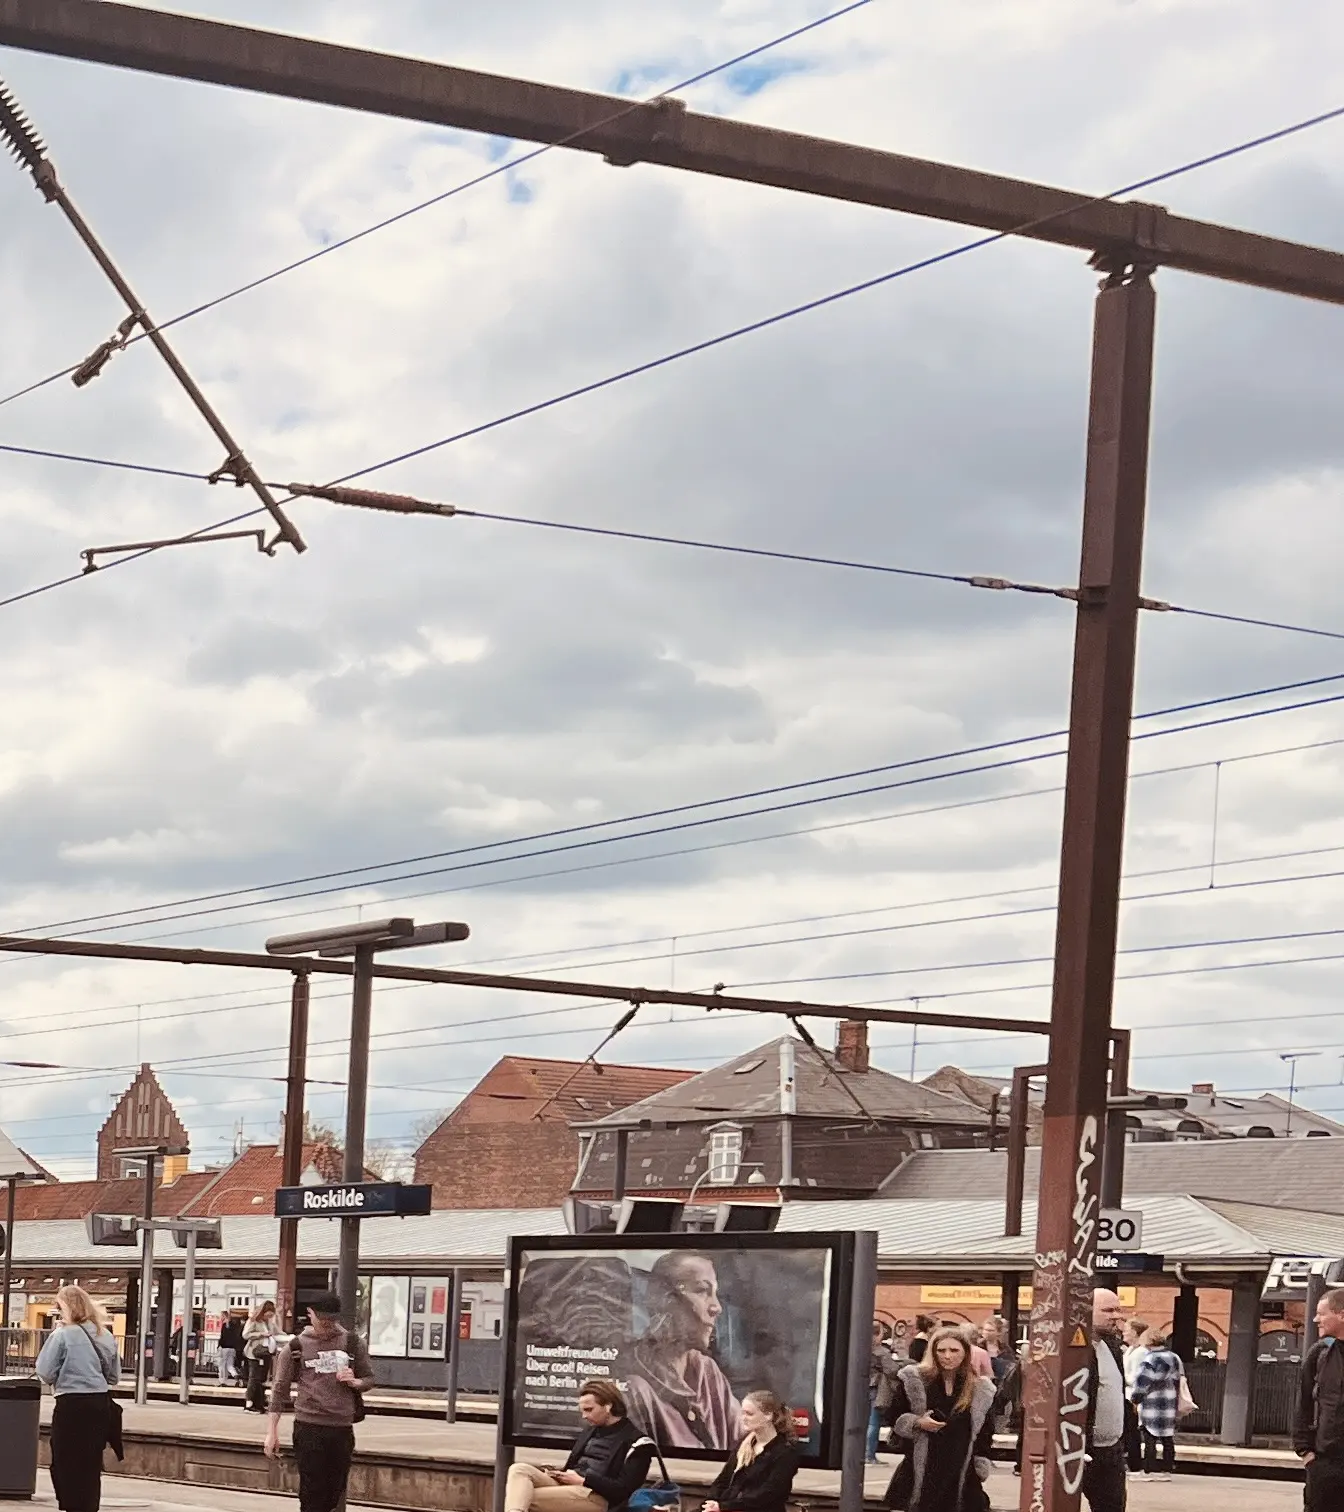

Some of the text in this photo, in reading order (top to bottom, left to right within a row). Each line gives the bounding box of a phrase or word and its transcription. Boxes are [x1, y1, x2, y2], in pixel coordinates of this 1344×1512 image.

[303, 1188, 365, 1209] Roskilde
[1095, 1255, 1119, 1268] ilde
[526, 1344, 619, 1360] Umweltfreundlich?
[526, 1357, 550, 1372] Über
[576, 1361, 610, 1375] Reisen
[525, 1375, 548, 1386] nach
[549, 1375, 578, 1388] Berlin
